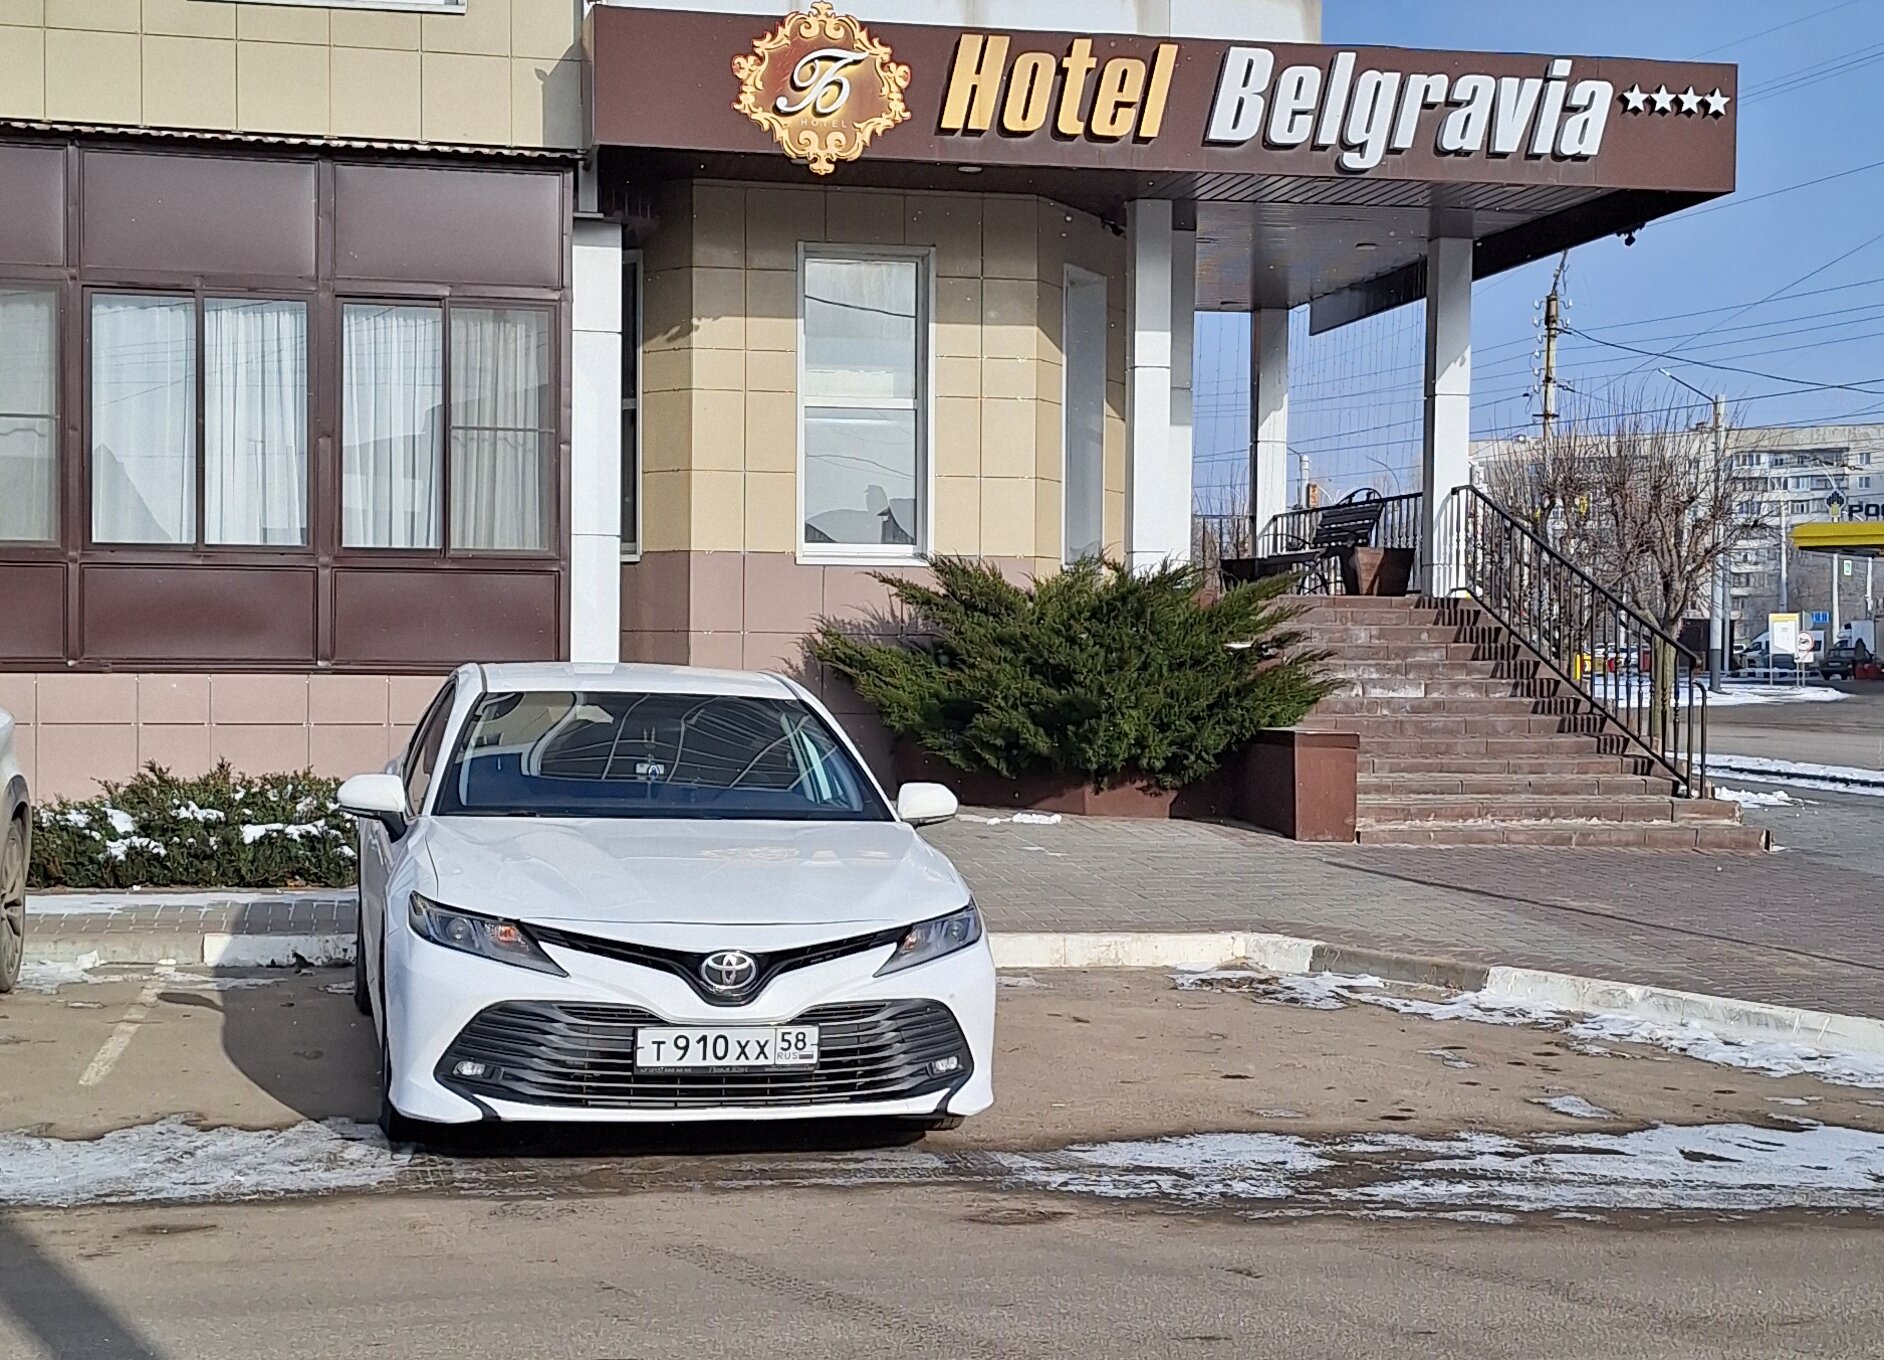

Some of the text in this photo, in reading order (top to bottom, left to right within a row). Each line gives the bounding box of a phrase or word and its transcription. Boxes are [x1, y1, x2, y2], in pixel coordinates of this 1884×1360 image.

[938, 33, 1614, 170] Hotel Belgravia
[800, 118, 847, 128] HOTEL
[780, 1031, 807, 1051] 58
[777, 1051, 798, 1060] RUS
